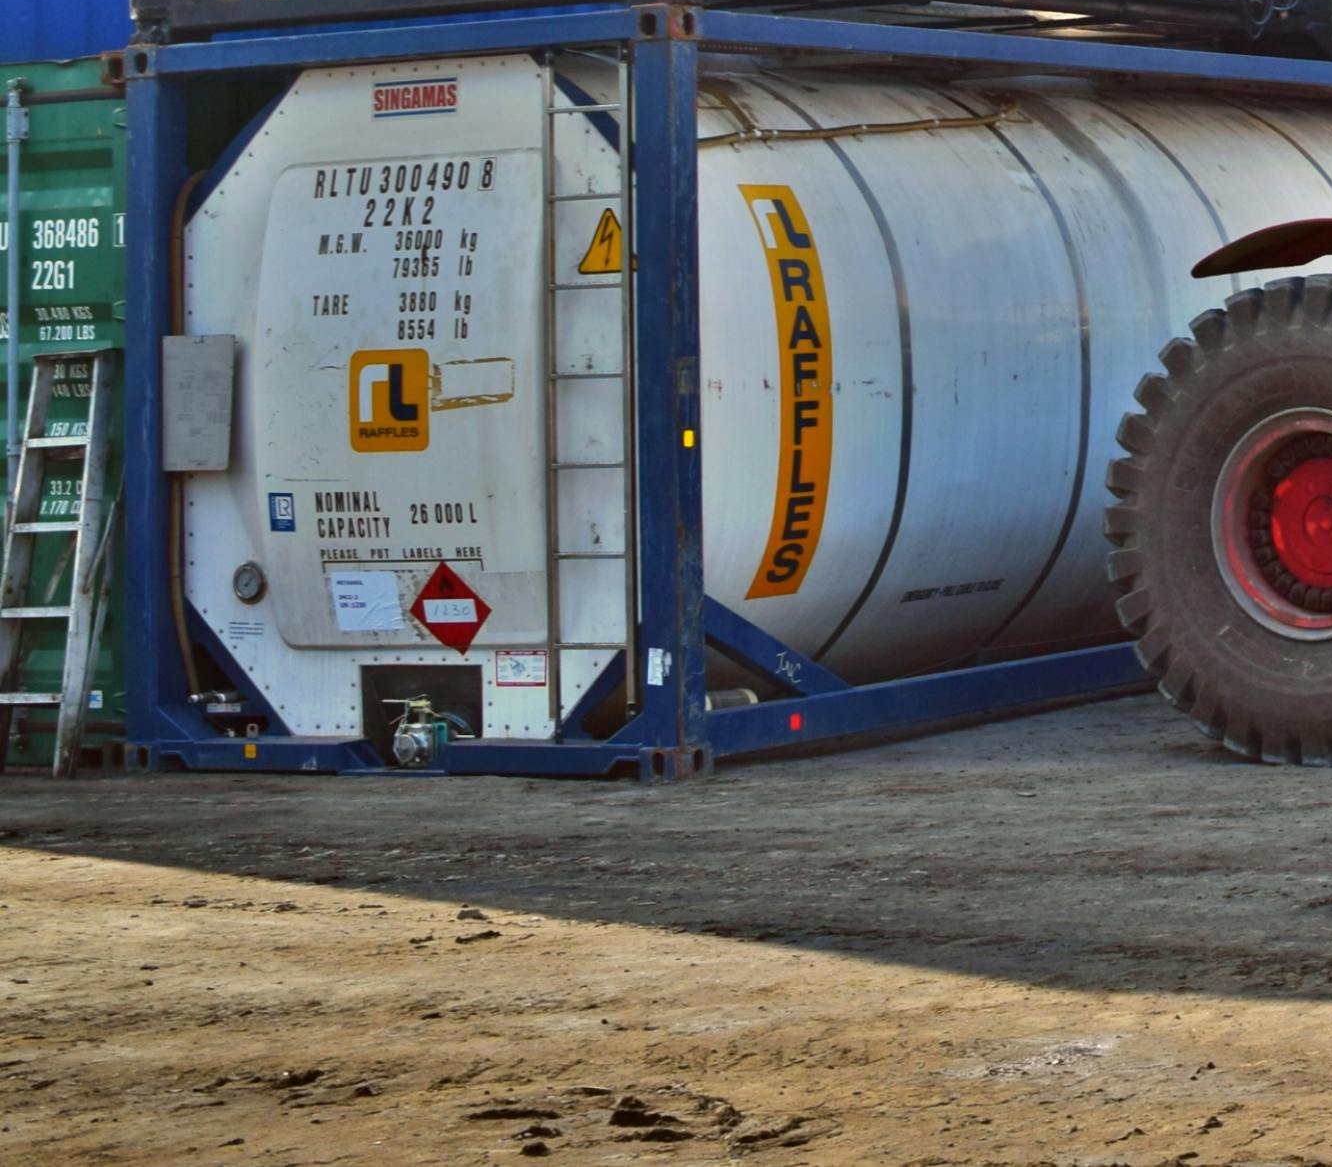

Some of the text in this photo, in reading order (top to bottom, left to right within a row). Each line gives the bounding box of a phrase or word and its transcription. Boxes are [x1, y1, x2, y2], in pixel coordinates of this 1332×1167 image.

[374, 84, 457, 111] SINGAMAS
[314, 160, 493, 198] RLTU 300490 8
[364, 196, 434, 227] 22K2
[33, 218, 99, 249] 368486
[318, 228, 478, 255] M.G.W. 36000 kg
[32, 260, 75, 290] 22G1
[393, 256, 473, 278] 79365 lb
[313, 290, 471, 316] TARE 3880 kg
[76, 325, 95, 340] LBS
[398, 318, 468, 340] 8554 lb
[53, 364, 66, 379] 30
[359, 427, 419, 438] RAFFLES
[766, 258, 822, 583] RAFFLES
[50, 480, 71, 495] 33.2
[315, 491, 478, 524] NOMINAL 26 000 L
[317, 517, 391, 539] CAPACITY
[320, 546, 483, 560] PLEASE PUT LABELS HERE
[433, 603, 471, 617] 1230
